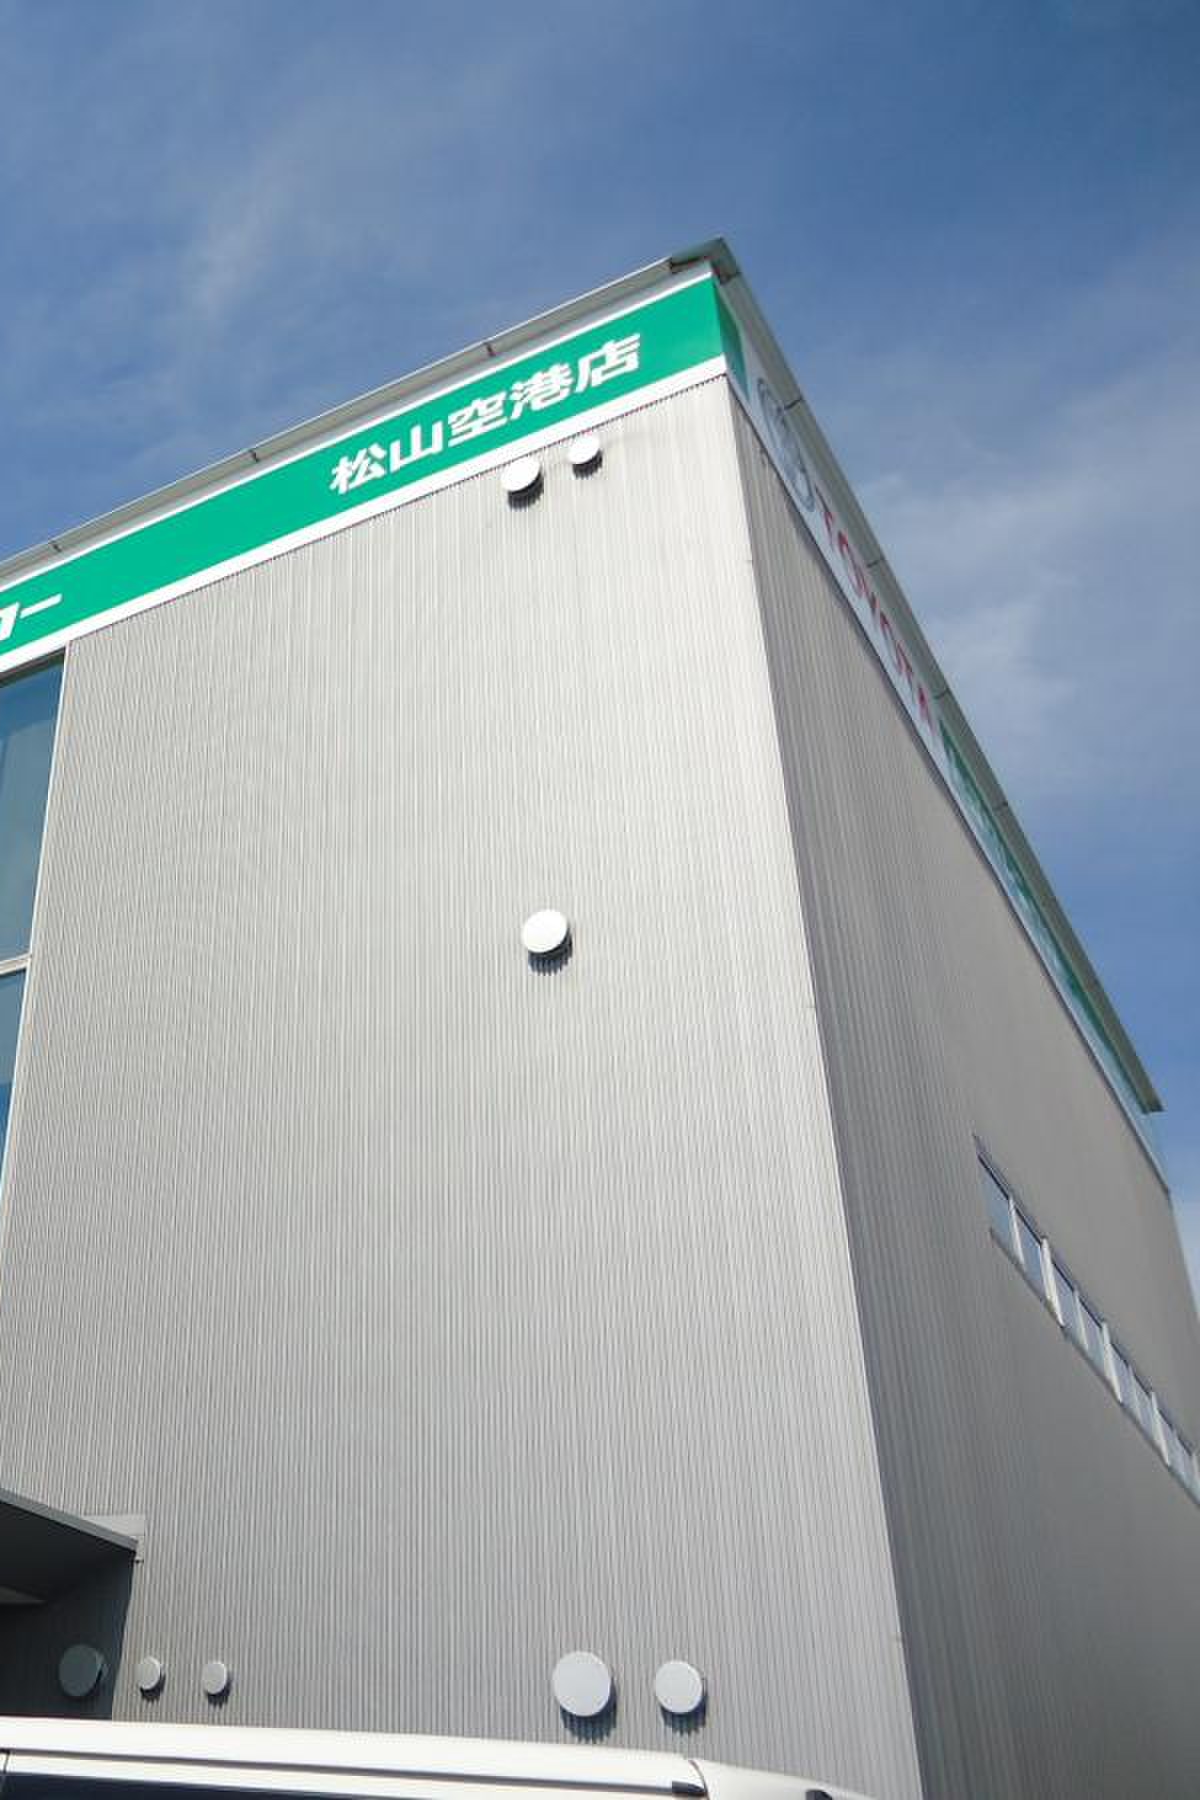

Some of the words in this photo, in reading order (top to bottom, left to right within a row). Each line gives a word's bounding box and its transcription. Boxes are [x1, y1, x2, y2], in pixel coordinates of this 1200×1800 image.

[329, 332, 641, 495] 松山空港店
